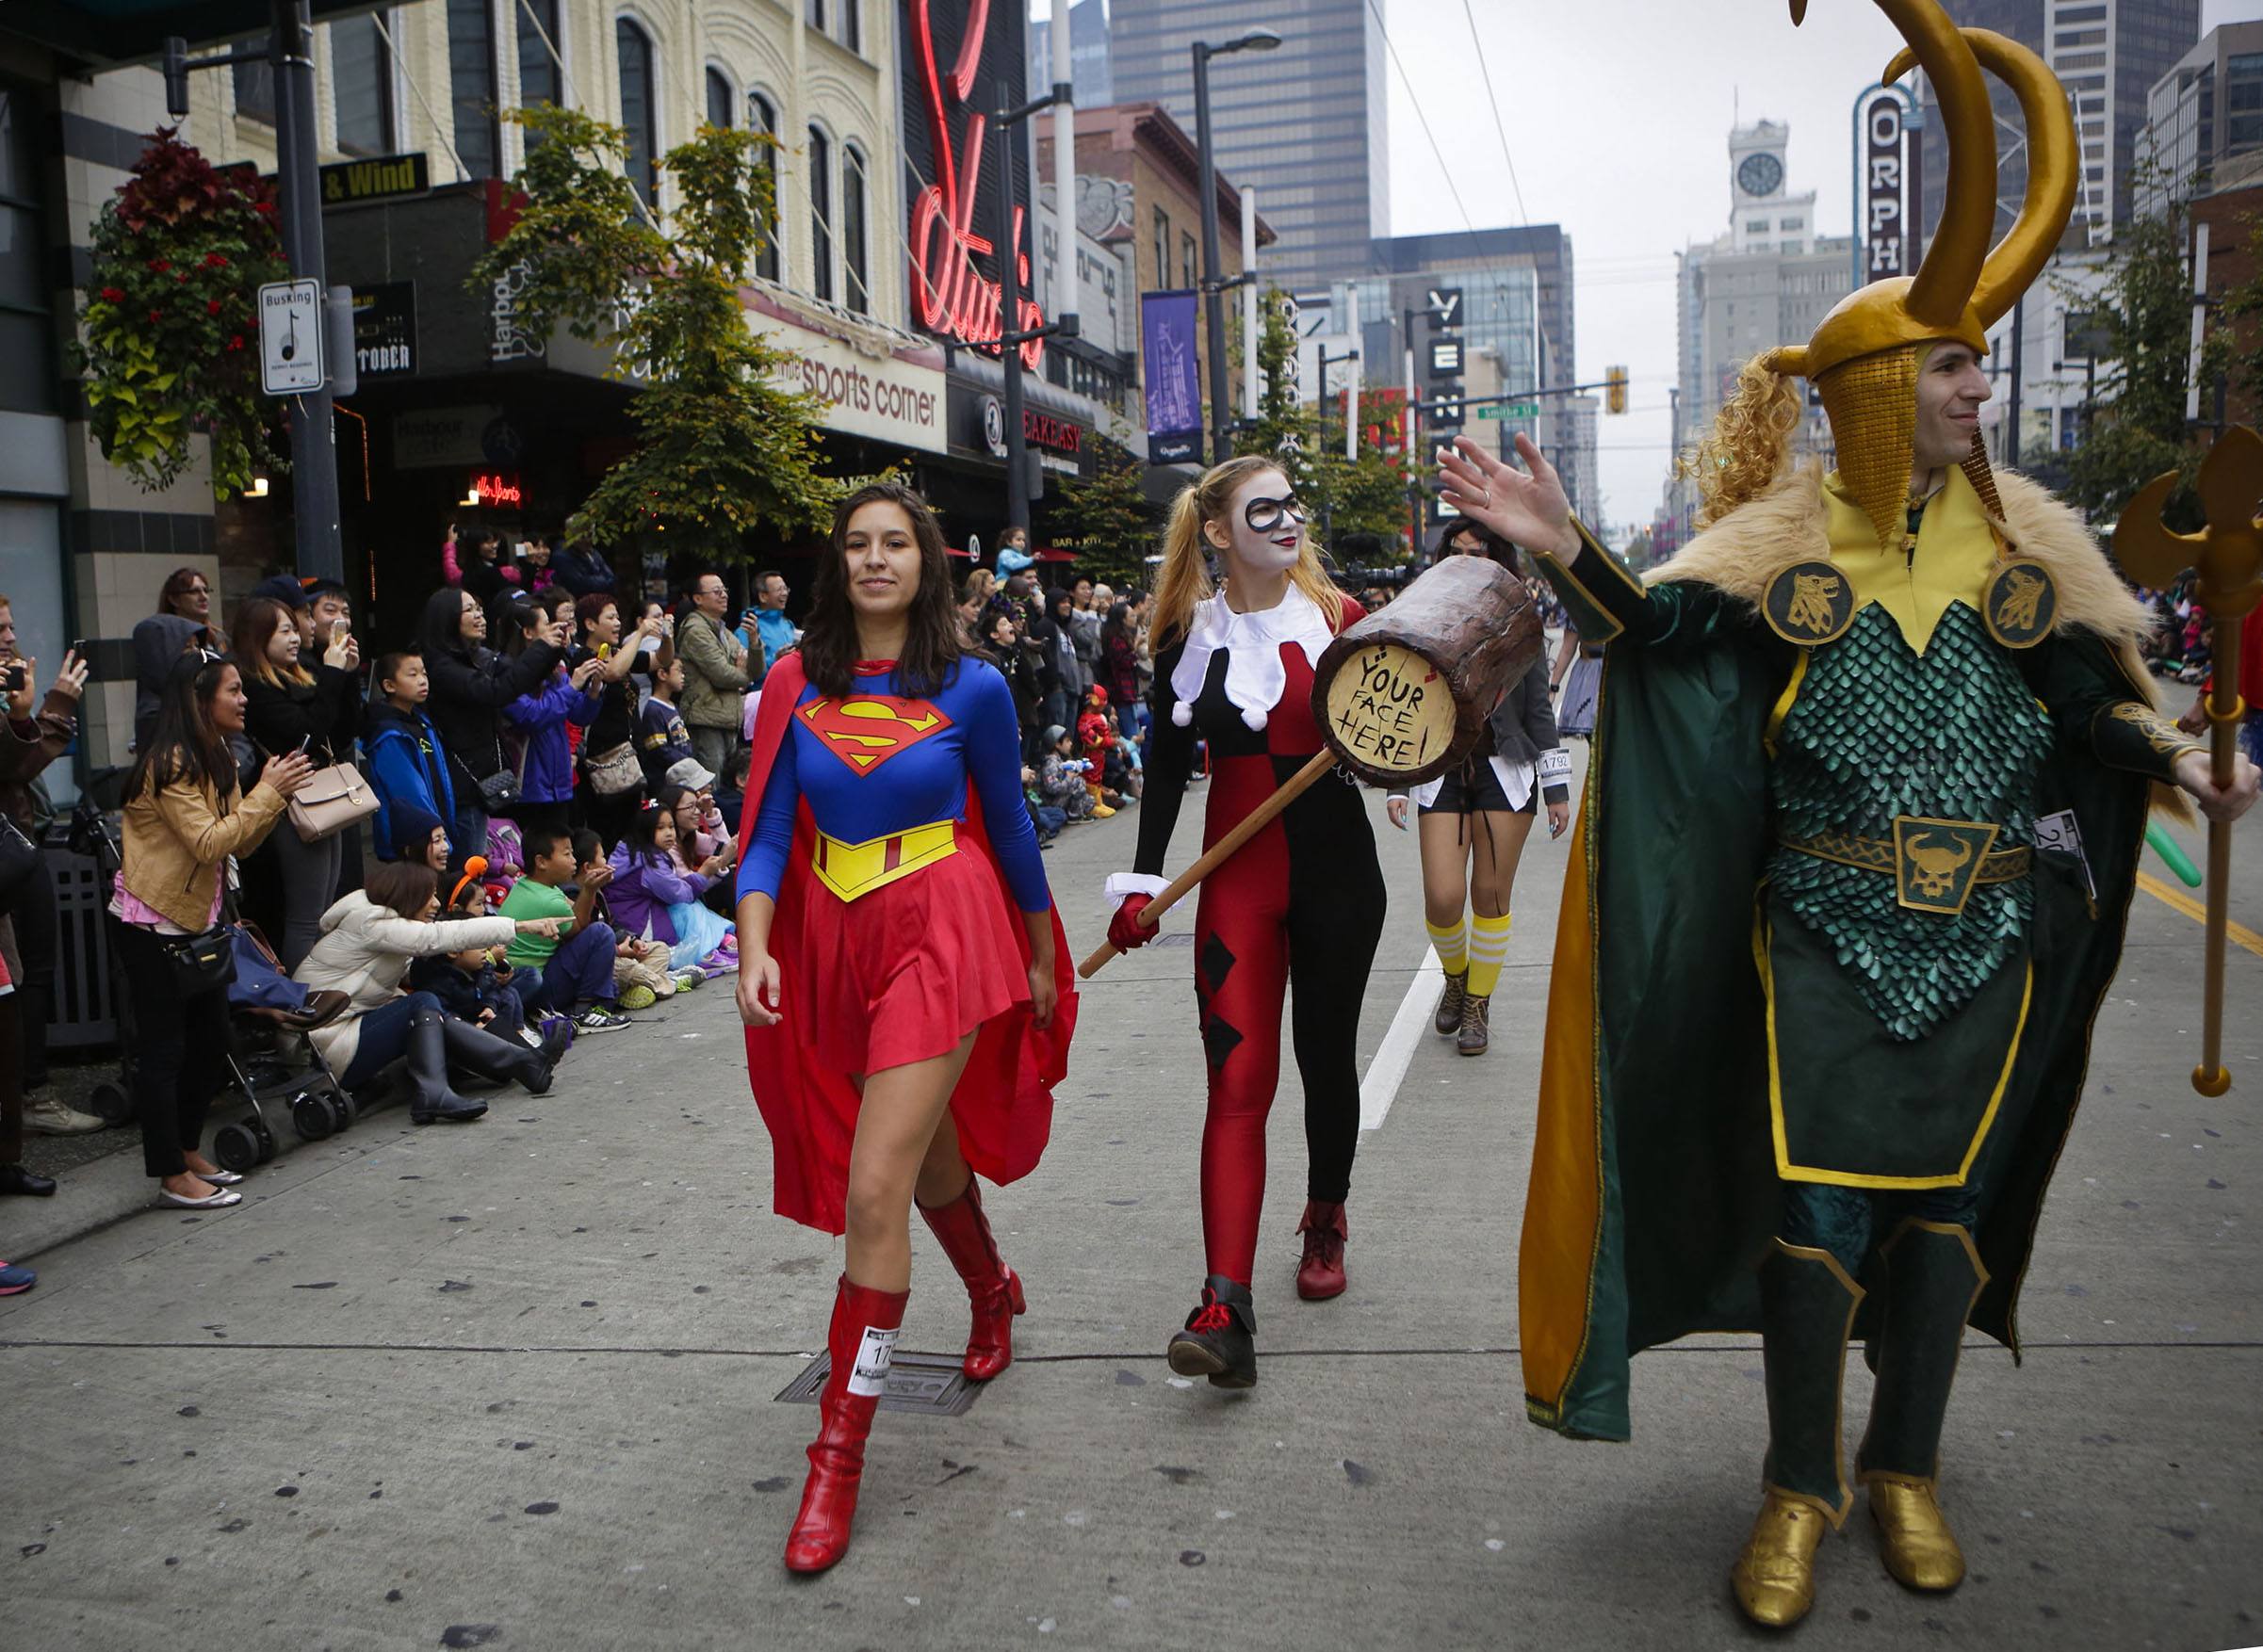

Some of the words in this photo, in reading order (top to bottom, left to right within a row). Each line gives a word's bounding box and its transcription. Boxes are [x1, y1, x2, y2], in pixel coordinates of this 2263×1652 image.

[326, 172, 343, 201] &
[346, 157, 415, 197] Wind
[1871, 107, 1899, 272] ORPH
[492, 264, 514, 362] Harbou
[357, 345, 410, 373] TOBER
[803, 358, 871, 412] sports
[875, 380, 936, 427] corner
[1023, 410, 1083, 453] EAKEASY
[1051, 537, 1073, 547] BAR
[1360, 656, 1424, 713] YOUR
[1350, 688, 1414, 733] FACE
[1335, 708, 1428, 766] HERE!
[874, 1341, 895, 1365] 17
